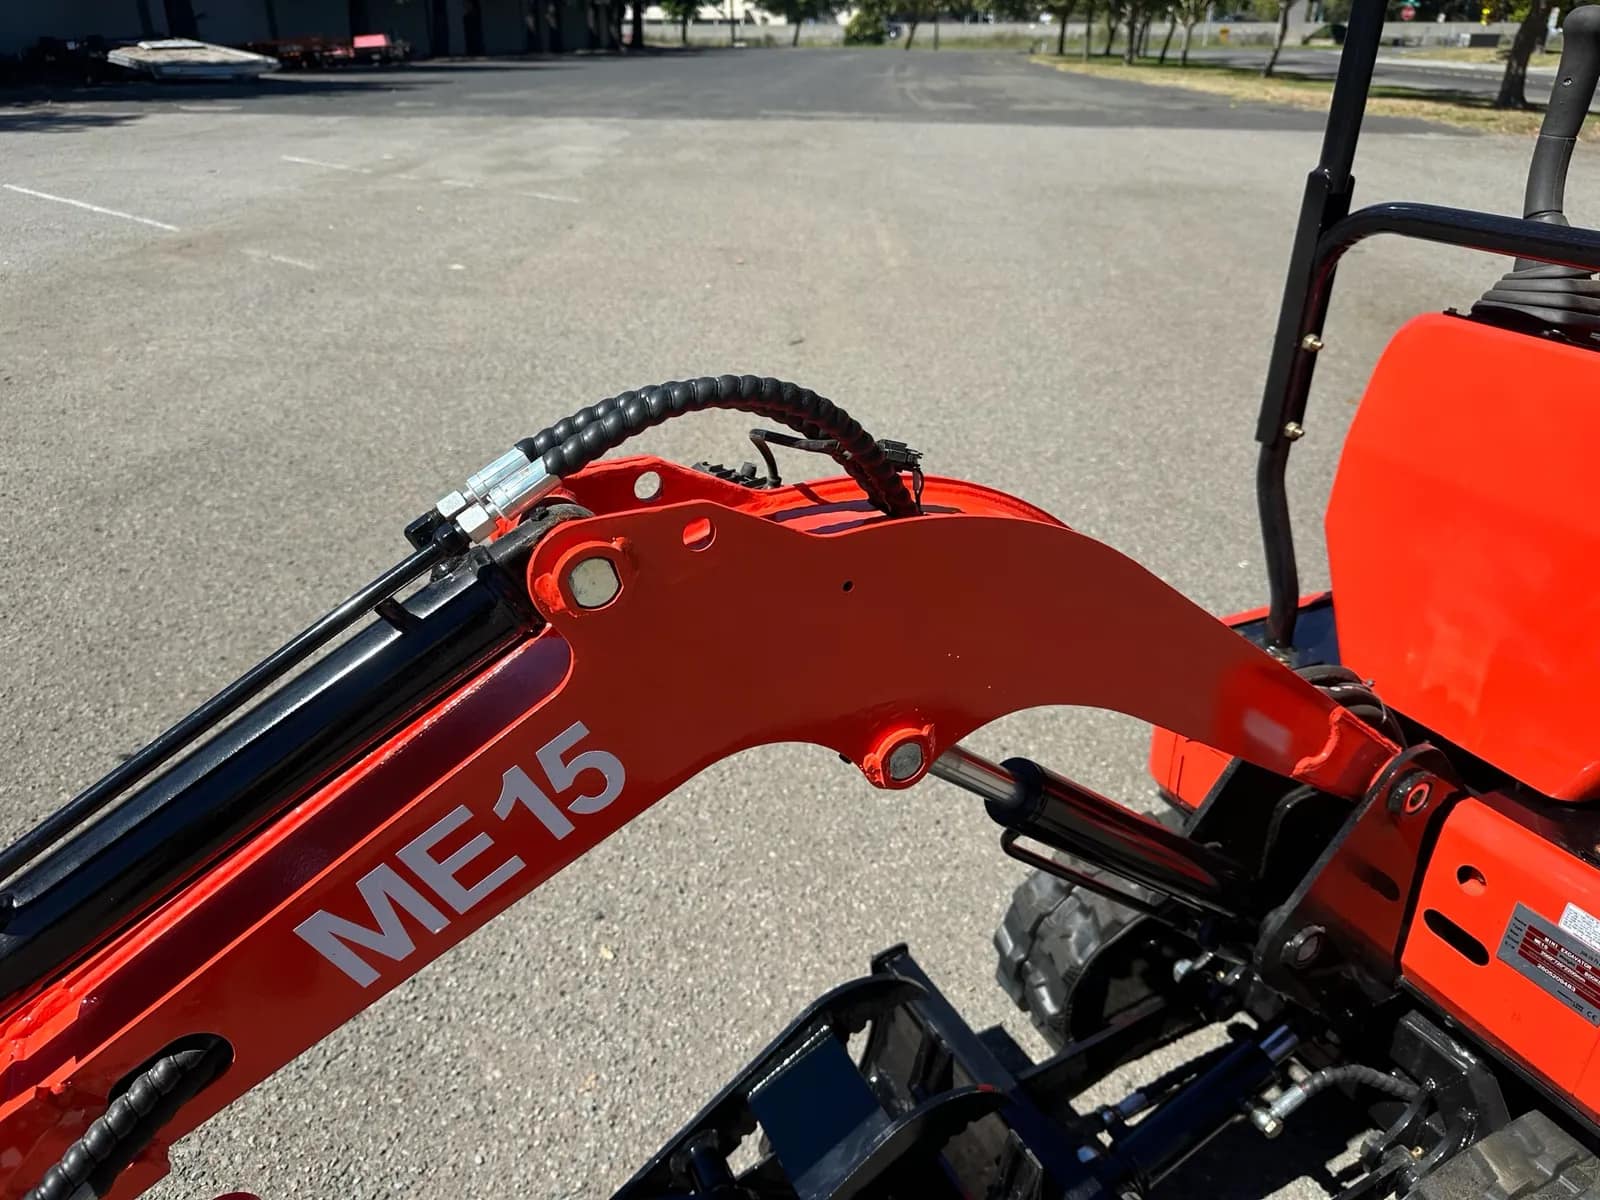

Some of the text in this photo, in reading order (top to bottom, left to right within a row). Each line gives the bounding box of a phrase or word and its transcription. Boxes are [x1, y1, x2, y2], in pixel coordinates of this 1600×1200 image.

[293, 720, 626, 988] ME15
[1544, 936, 1558, 949] MINI
[1560, 947, 1592, 970] EXCAVATOR
